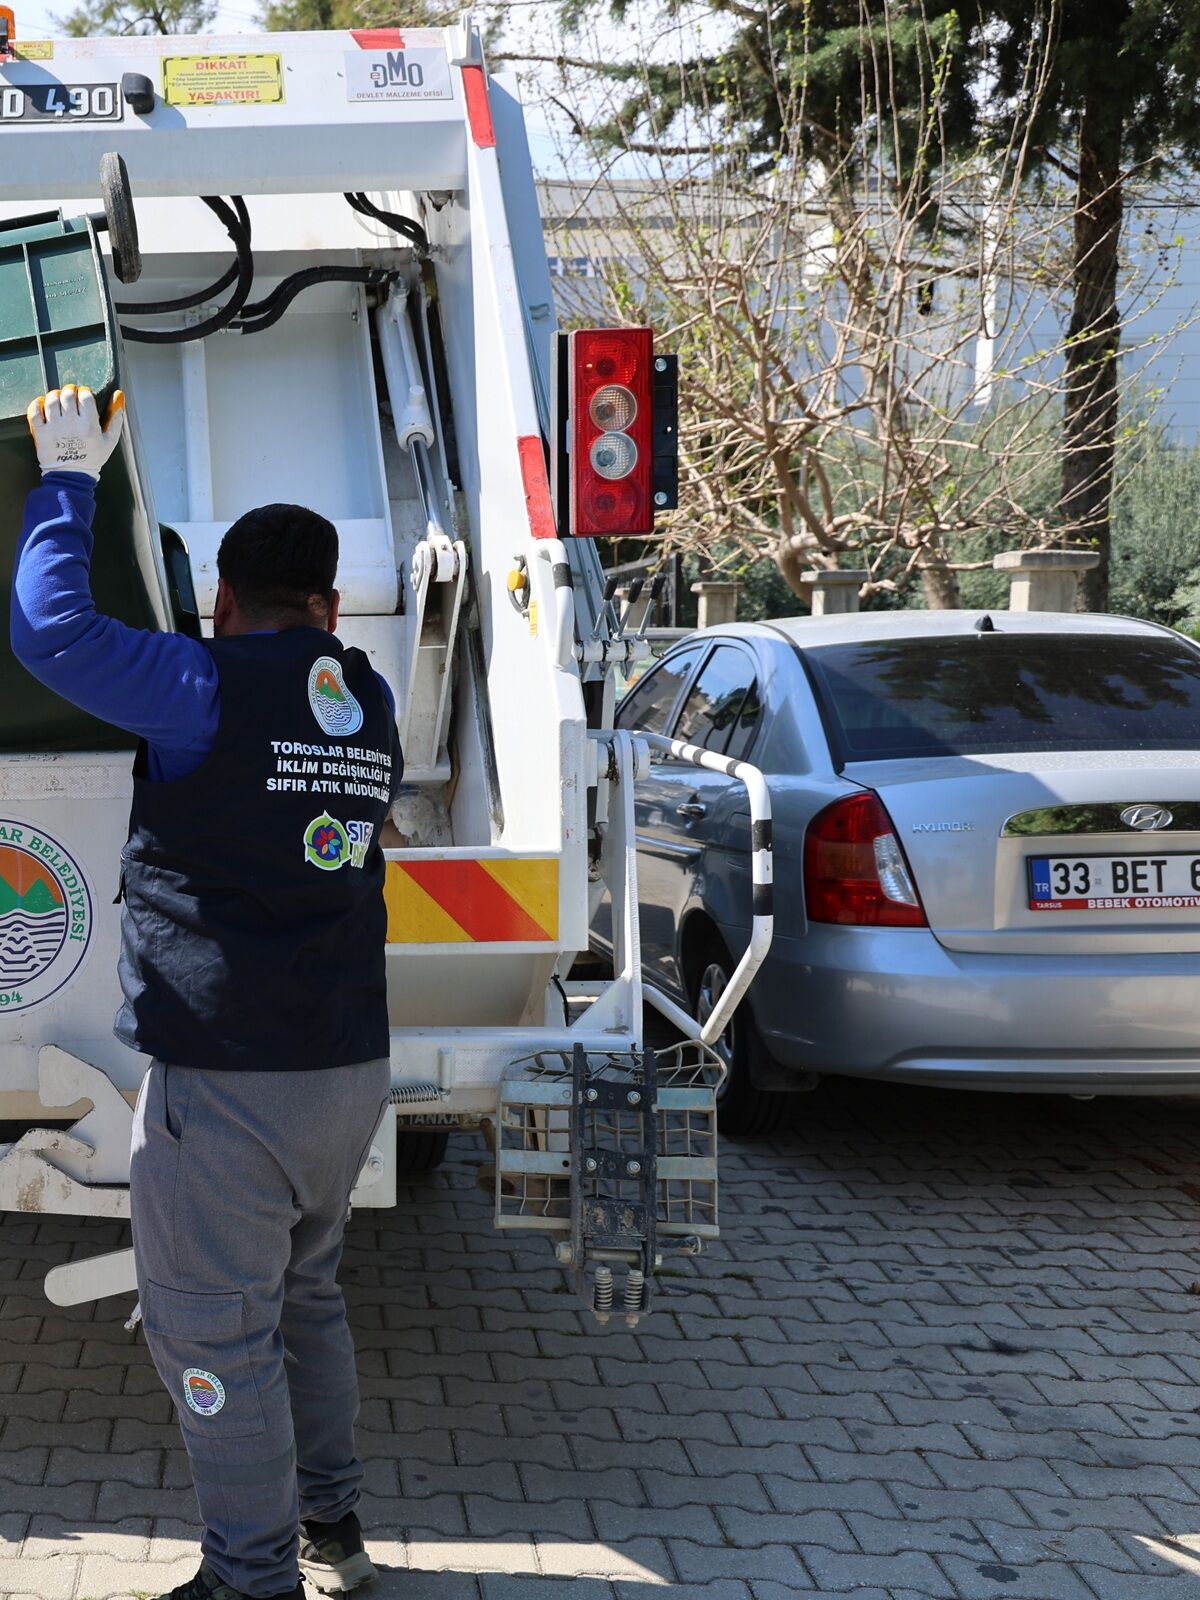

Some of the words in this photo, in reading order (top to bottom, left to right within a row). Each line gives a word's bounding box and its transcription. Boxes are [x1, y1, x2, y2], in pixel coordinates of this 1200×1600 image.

[195, 60, 247, 71] DİKKAT!
[45, 87, 114, 117] 490
[189, 91, 260, 101] YASAKTIR!
[270, 741, 344, 758] TOROSLAR
[346, 747, 392, 768] BELEDİYESİ
[276, 756, 319, 774] İKLİM
[322, 760, 383, 782] DEĞİŞİKLİĞİ
[383, 771, 392, 785] VE
[266, 778, 307, 792] SIFIR
[311, 780, 341, 794] ATIK
[28, 835, 86, 943] BELEDİYESİ
[1035, 882, 1050, 893] TR
[1053, 862, 1091, 896] 33
[1111, 859, 1168, 894] BET
[1087, 898, 1131, 909] BEBEK
